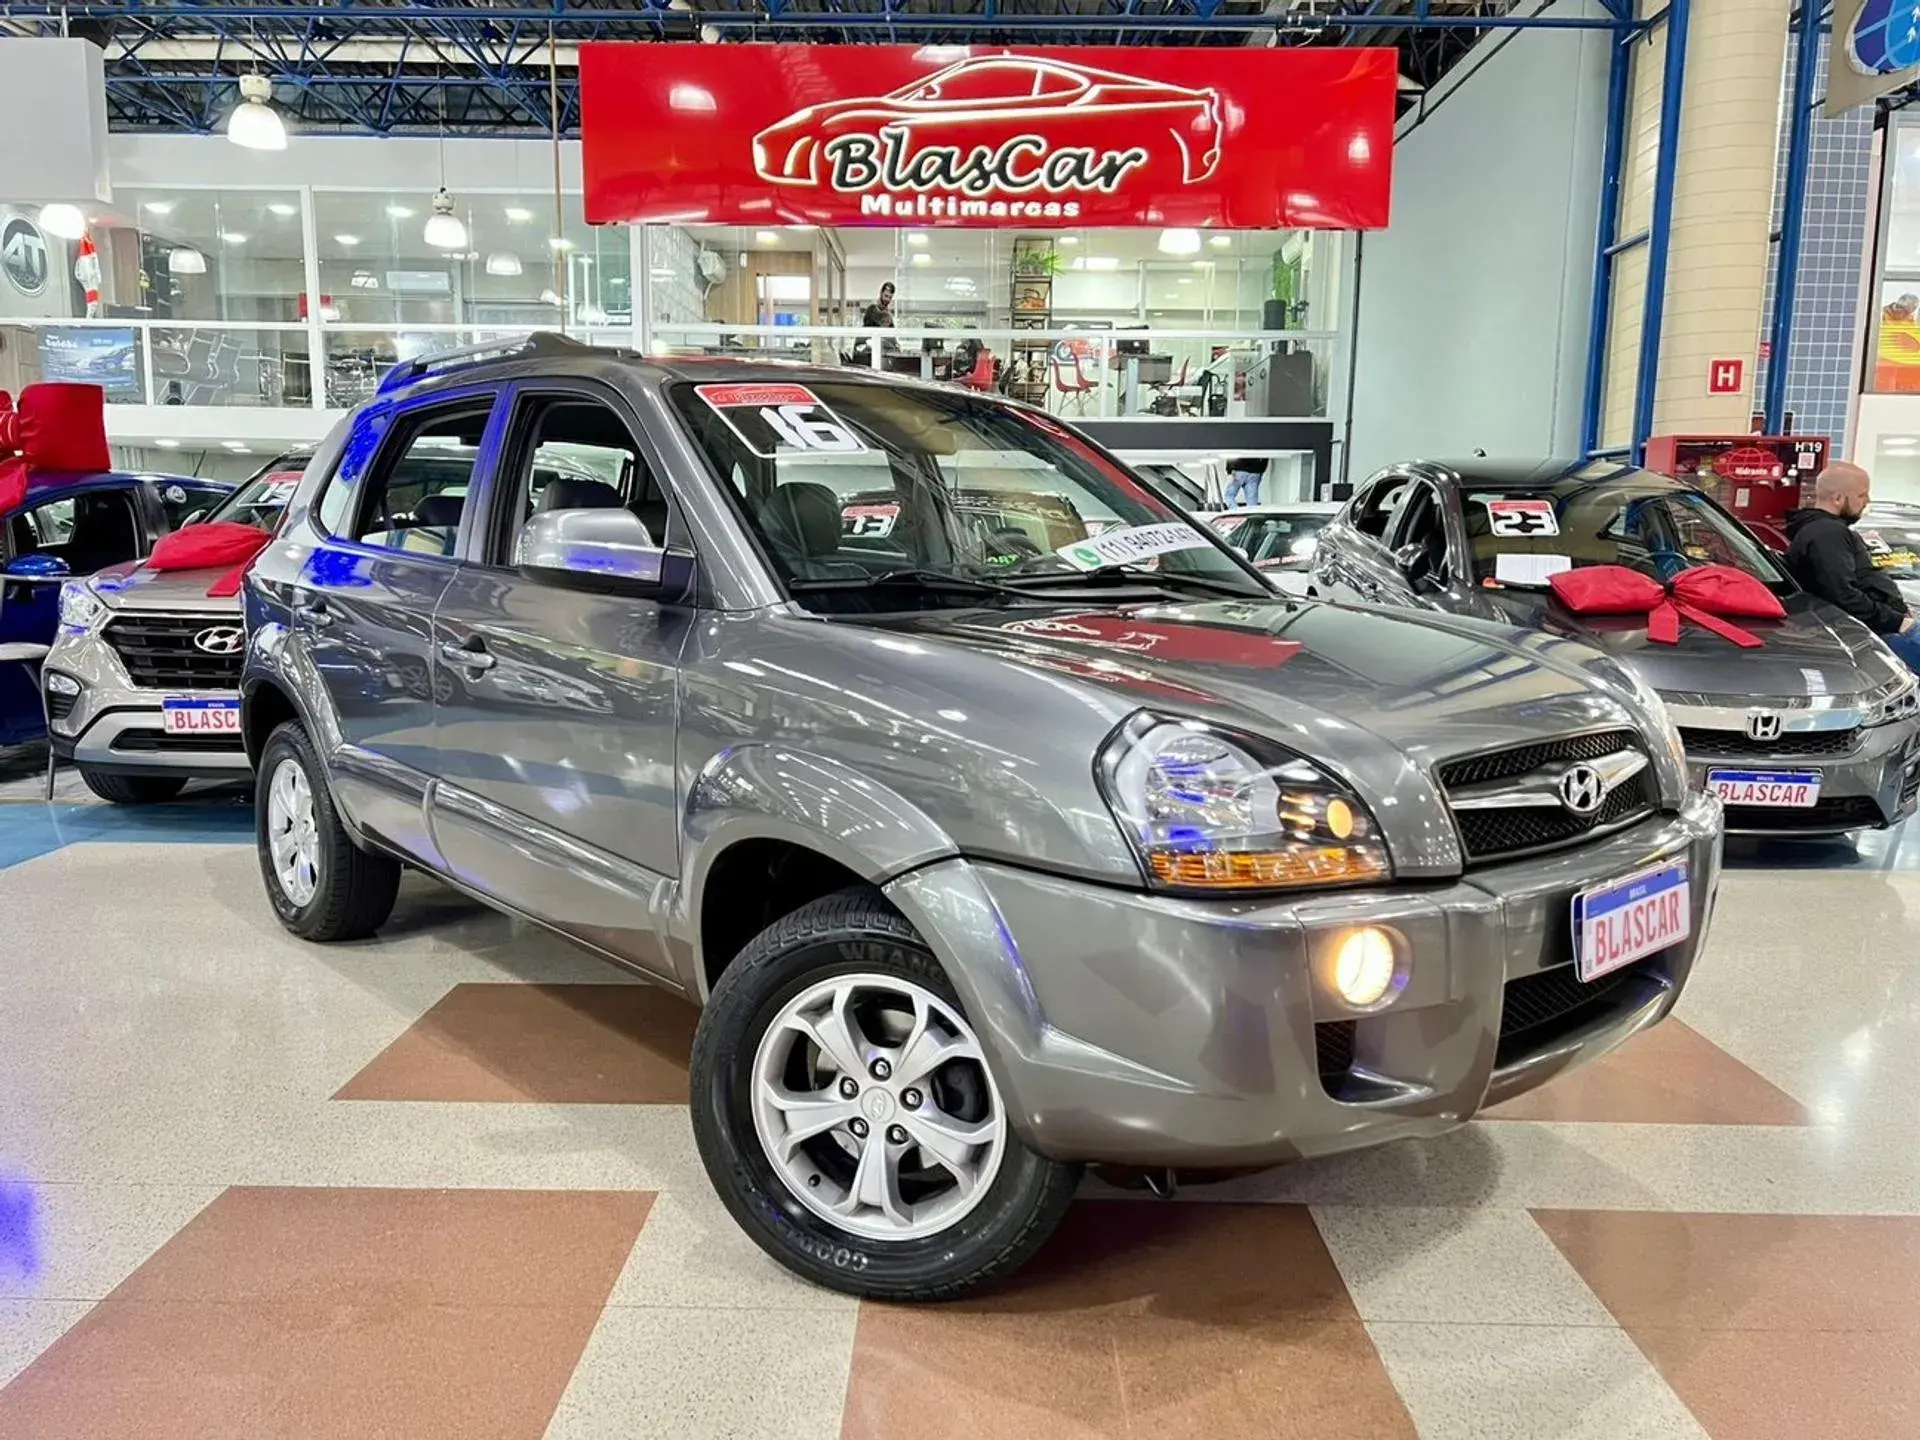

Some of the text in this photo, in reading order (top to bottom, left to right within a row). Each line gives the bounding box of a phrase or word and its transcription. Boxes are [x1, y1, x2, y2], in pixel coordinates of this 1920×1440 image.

[826, 127, 1146, 195] BlasCar
[860, 194, 1080, 217] Multimarcas
[1716, 365, 1735, 387] H
[759, 405, 860, 450] 16
[1495, 511, 1556, 534] 23
[174, 711, 240, 729] BLASC
[1718, 783, 1808, 803] BLASCAR
[1595, 890, 1680, 966] BLASCAR
